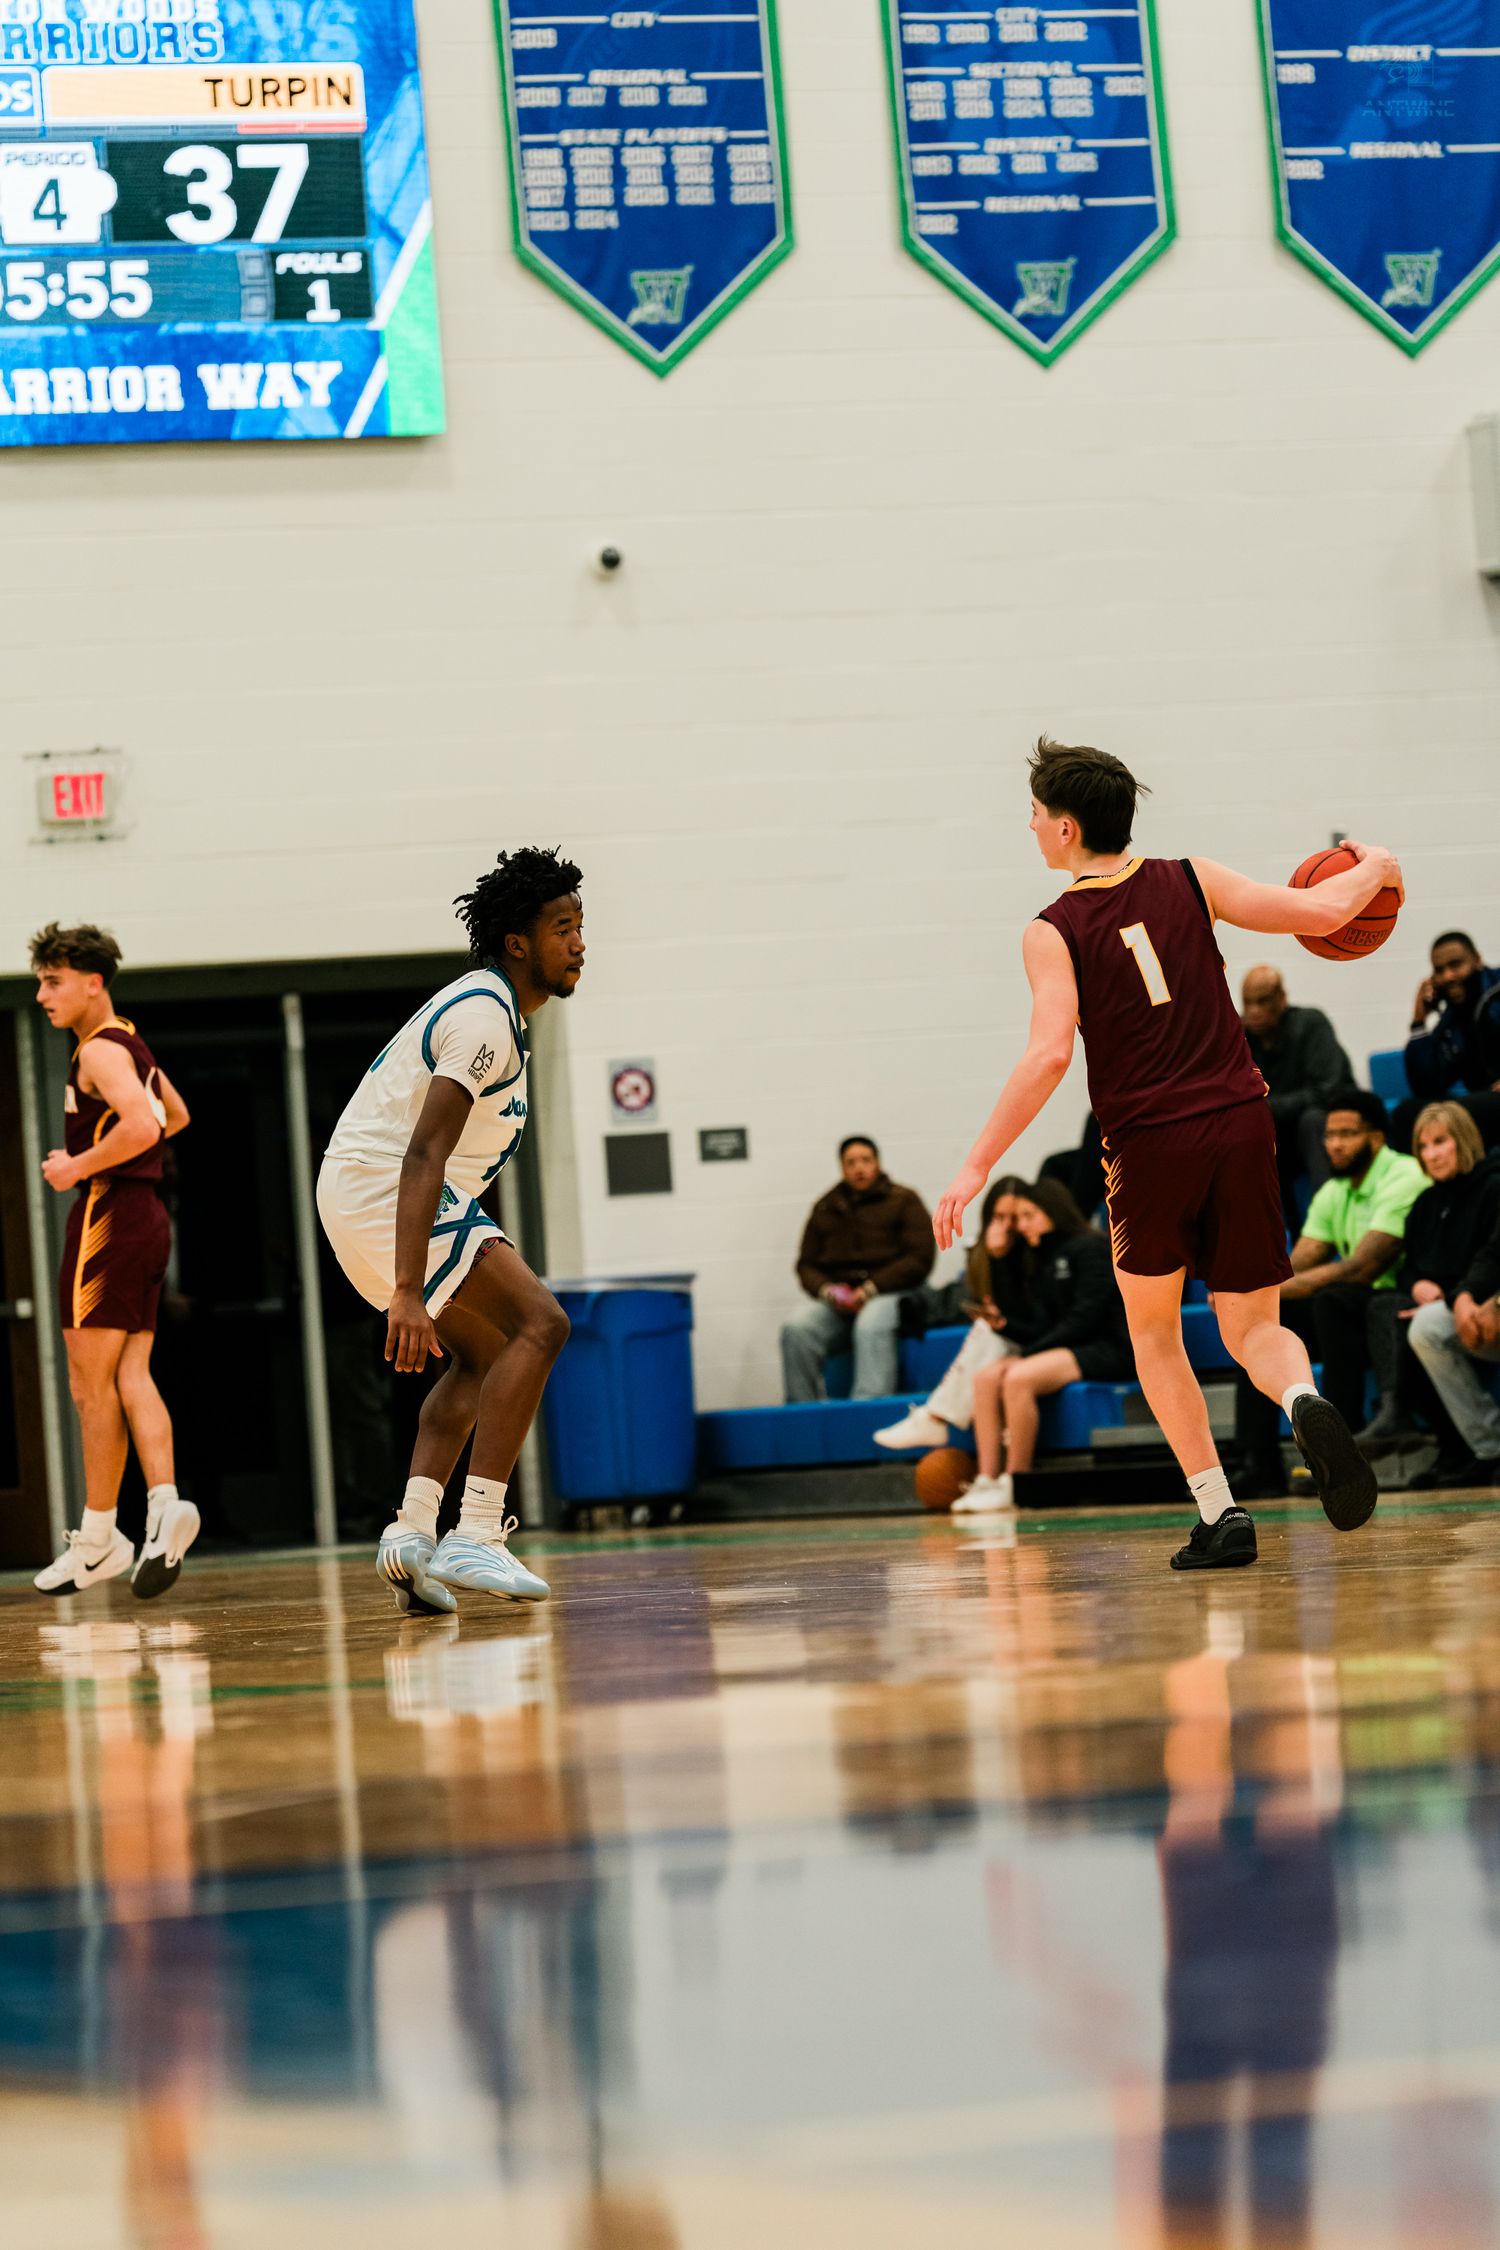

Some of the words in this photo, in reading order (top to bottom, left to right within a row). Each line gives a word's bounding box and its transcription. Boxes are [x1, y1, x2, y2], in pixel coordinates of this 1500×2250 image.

[611, 12, 656, 27] CITY
[1347, 45, 1431, 61] DISTRICT
[589, 69, 687, 85] REGIONAL
[970, 62, 1073, 78] SECTIONAL
[204, 77, 352, 107] TURPIN
[625, 127, 727, 144] PLAYOFFS
[984, 136, 1072, 153] DISTRICT
[5, 152, 87, 166] PERIOD
[1350, 142, 1442, 158] REGIONAL
[163, 143, 309, 244] 37
[33, 179, 67, 230] 4
[985, 196, 1080, 212] REGIONAL
[276, 252, 362, 275] FOULS
[0, 260, 152, 320] 5:55
[307, 279, 340, 322] 1
[197, 361, 343, 410] WAY
[52, 772, 105, 819] EXIT
[1119, 921, 1172, 1007] 1
